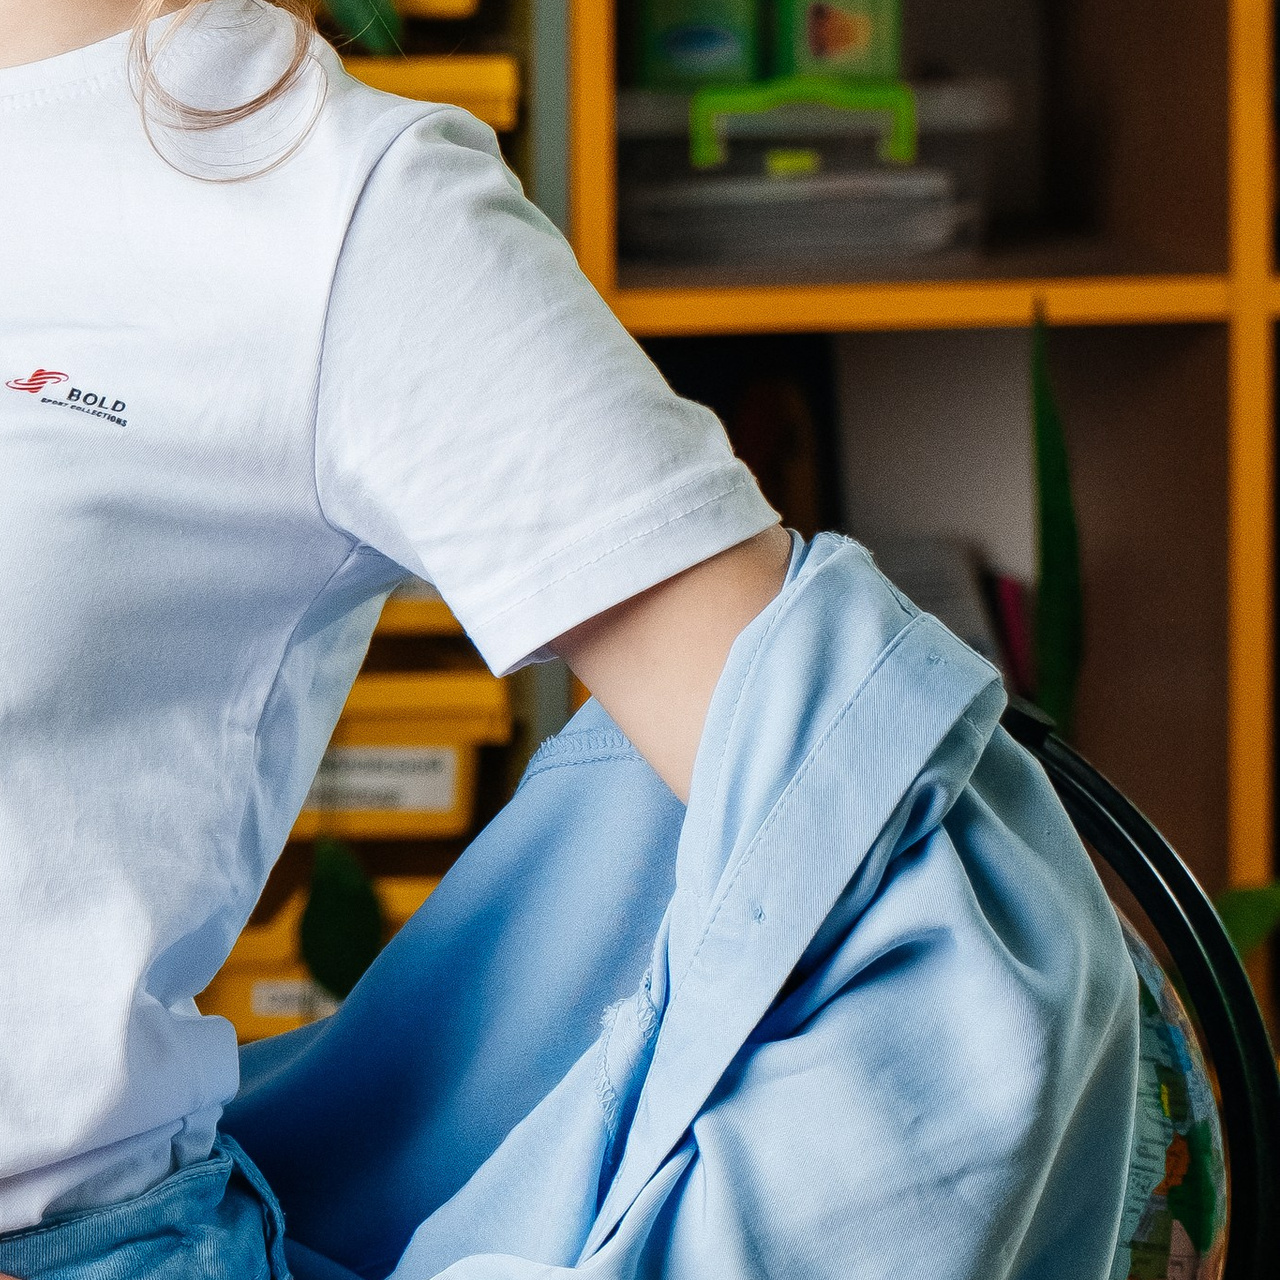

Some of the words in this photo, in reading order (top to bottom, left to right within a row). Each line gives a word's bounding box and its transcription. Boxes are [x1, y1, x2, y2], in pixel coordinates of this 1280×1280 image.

[40, 397, 69, 408] SPORT
[70, 404, 128, 427] COLLECTIONS
[67, 387, 126, 413] BOLD
